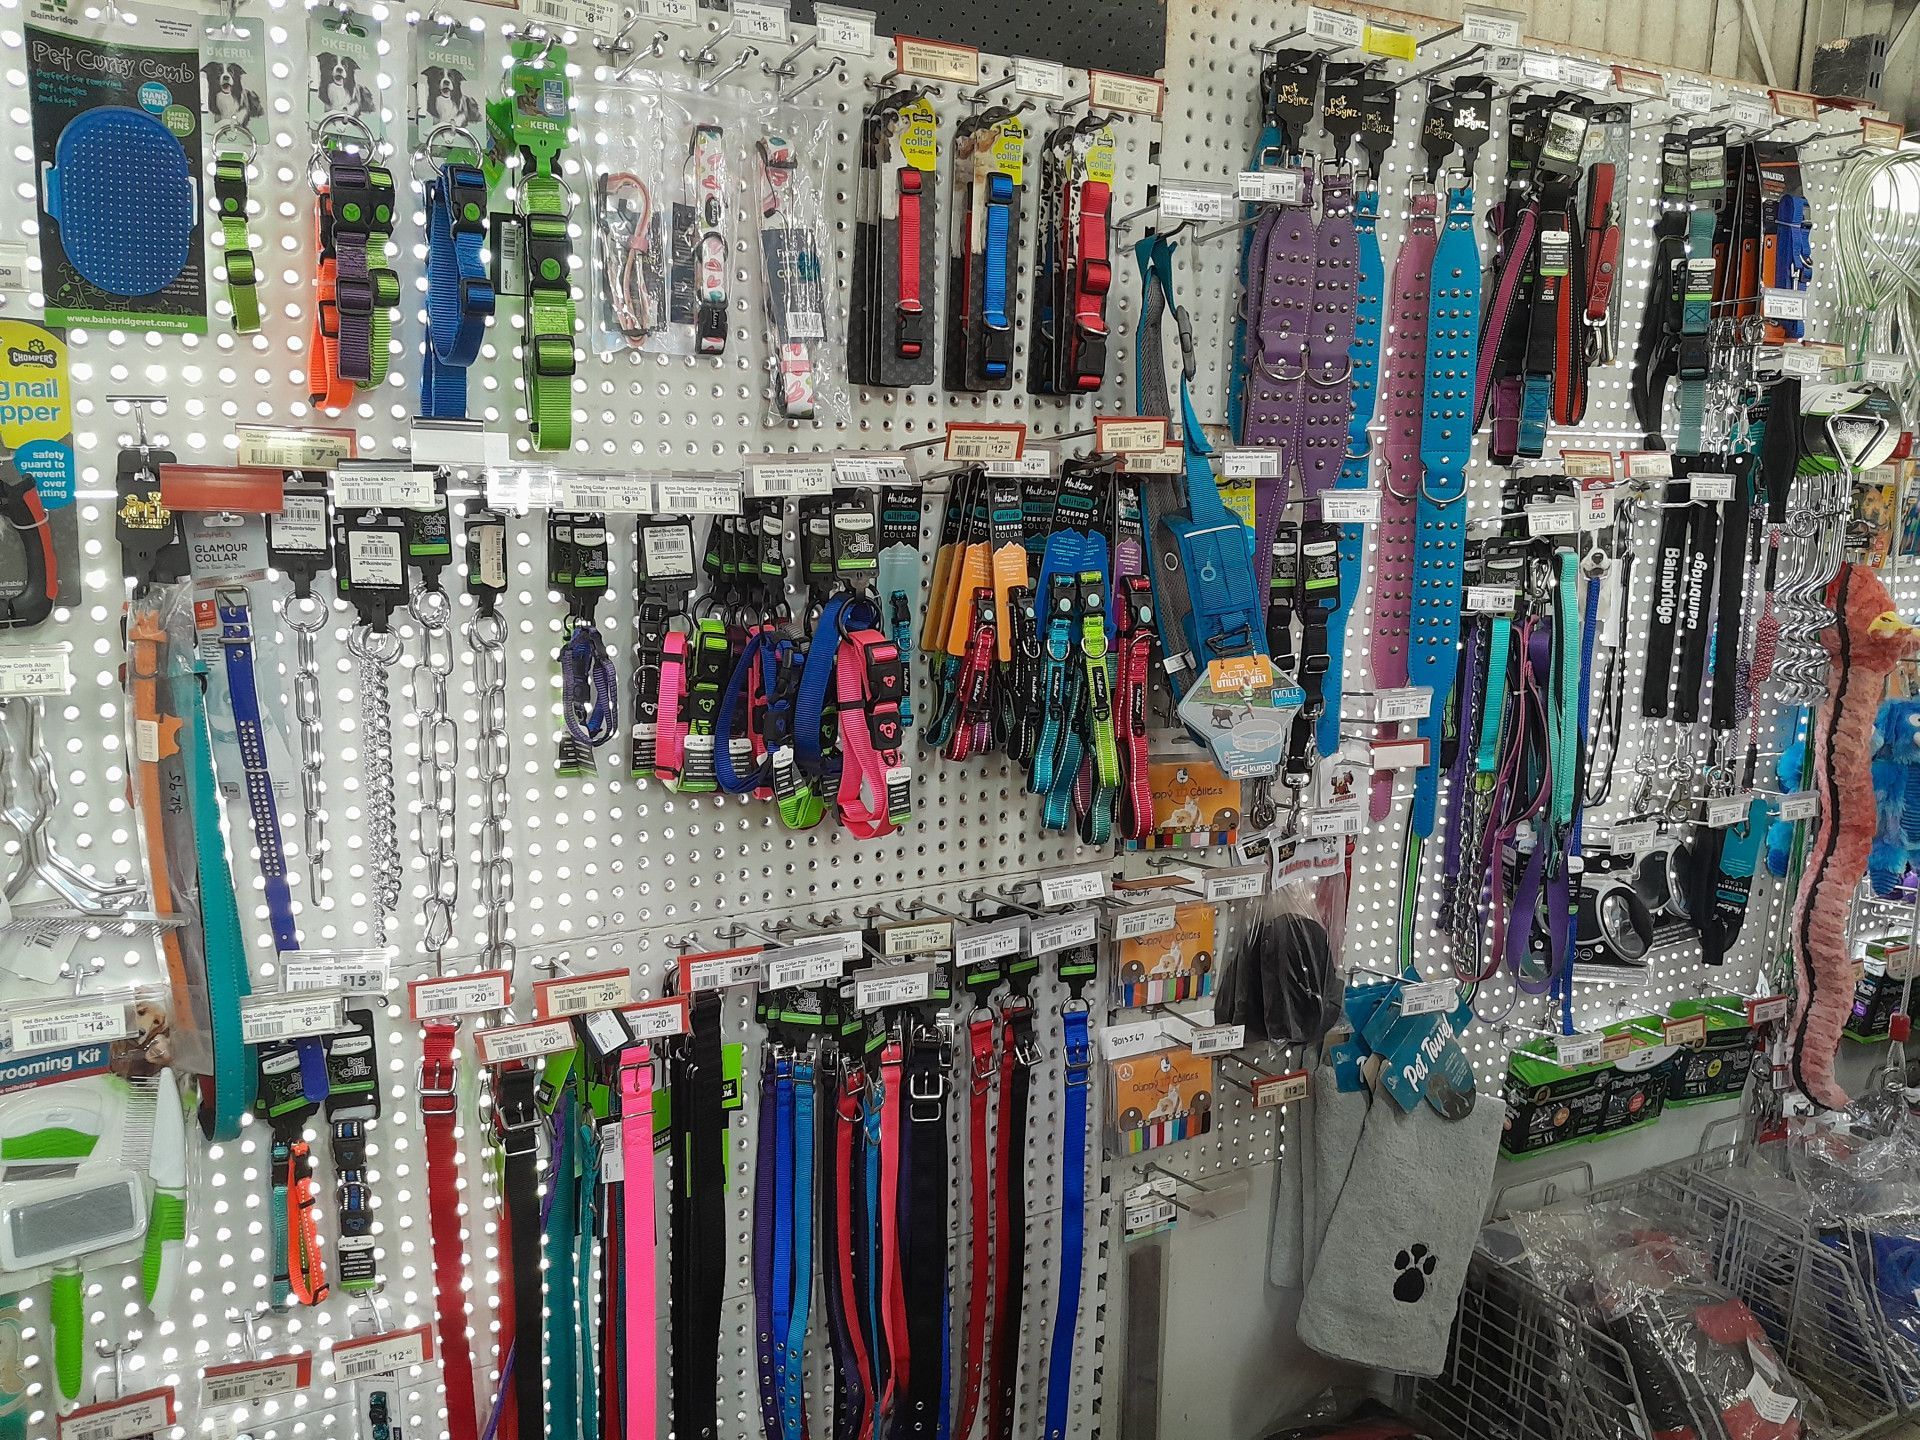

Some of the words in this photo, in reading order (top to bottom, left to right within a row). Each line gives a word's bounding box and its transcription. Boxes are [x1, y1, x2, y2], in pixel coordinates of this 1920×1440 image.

[31, 10, 78, 25] Bainbridge
[330, 39, 368, 55] KERBL
[215, 47, 252, 60] KERBL
[436, 51, 475, 67] KERBL
[33, 41, 73, 71] Pet
[76, 50, 135, 79] Curry
[139, 59, 194, 83] Comb
[1282, 82, 1298, 94] pet
[1330, 95, 1347, 107] pet
[1459, 107, 1476, 118] pet
[167, 120, 191, 131] PINS
[530, 121, 562, 132] KERBL
[913, 127, 933, 138] dog
[905, 136, 933, 146] collar
[1004, 142, 1021, 153] dog
[996, 151, 1021, 161] collar
[1097, 151, 1113, 163] dog
[1090, 160, 1112, 171] collar
[66, 315, 188, 328] www.bainbridgevet.com.au
[12, 352, 54, 364] CHOMPERS
[15, 378, 58, 398] nail
[32, 450, 64, 461] safety
[311, 448, 340, 460] $7.50
[21, 461, 52, 471] guard
[43, 480, 66, 488] over
[36, 490, 67, 499] utting
[1057, 509, 1089, 519] TREKPRO
[1589, 512, 1606, 520] LEAD
[1055, 516, 1087, 527] COLLAR
[855, 533, 870, 543] Dog
[883, 531, 918, 539] COLLAR
[995, 531, 1022, 539] COLLAR
[194, 543, 248, 553] GLAMOUR
[195, 554, 238, 562] COLLAR
[1656, 547, 1680, 624] Bainbridge
[1220, 668, 1263, 679] ACTIVE
[22, 674, 54, 685] $24.95
[1216, 677, 1244, 688] UTILITY
[1250, 675, 1267, 684] BELT
[1274, 689, 1300, 698] MOLLE
[1249, 764, 1271, 773] kurgo
[168, 772, 184, 815] $12.95
[343, 975, 380, 987] $15.95
[471, 992, 495, 1002] $20.95
[334, 1041, 369, 1049] Bainbridge
[77, 1049, 101, 1065] Kit
[1403, 1054, 1430, 1092] Pet
[1421, 1013, 1454, 1063] Towel
[348, 1057, 365, 1067] Dog
